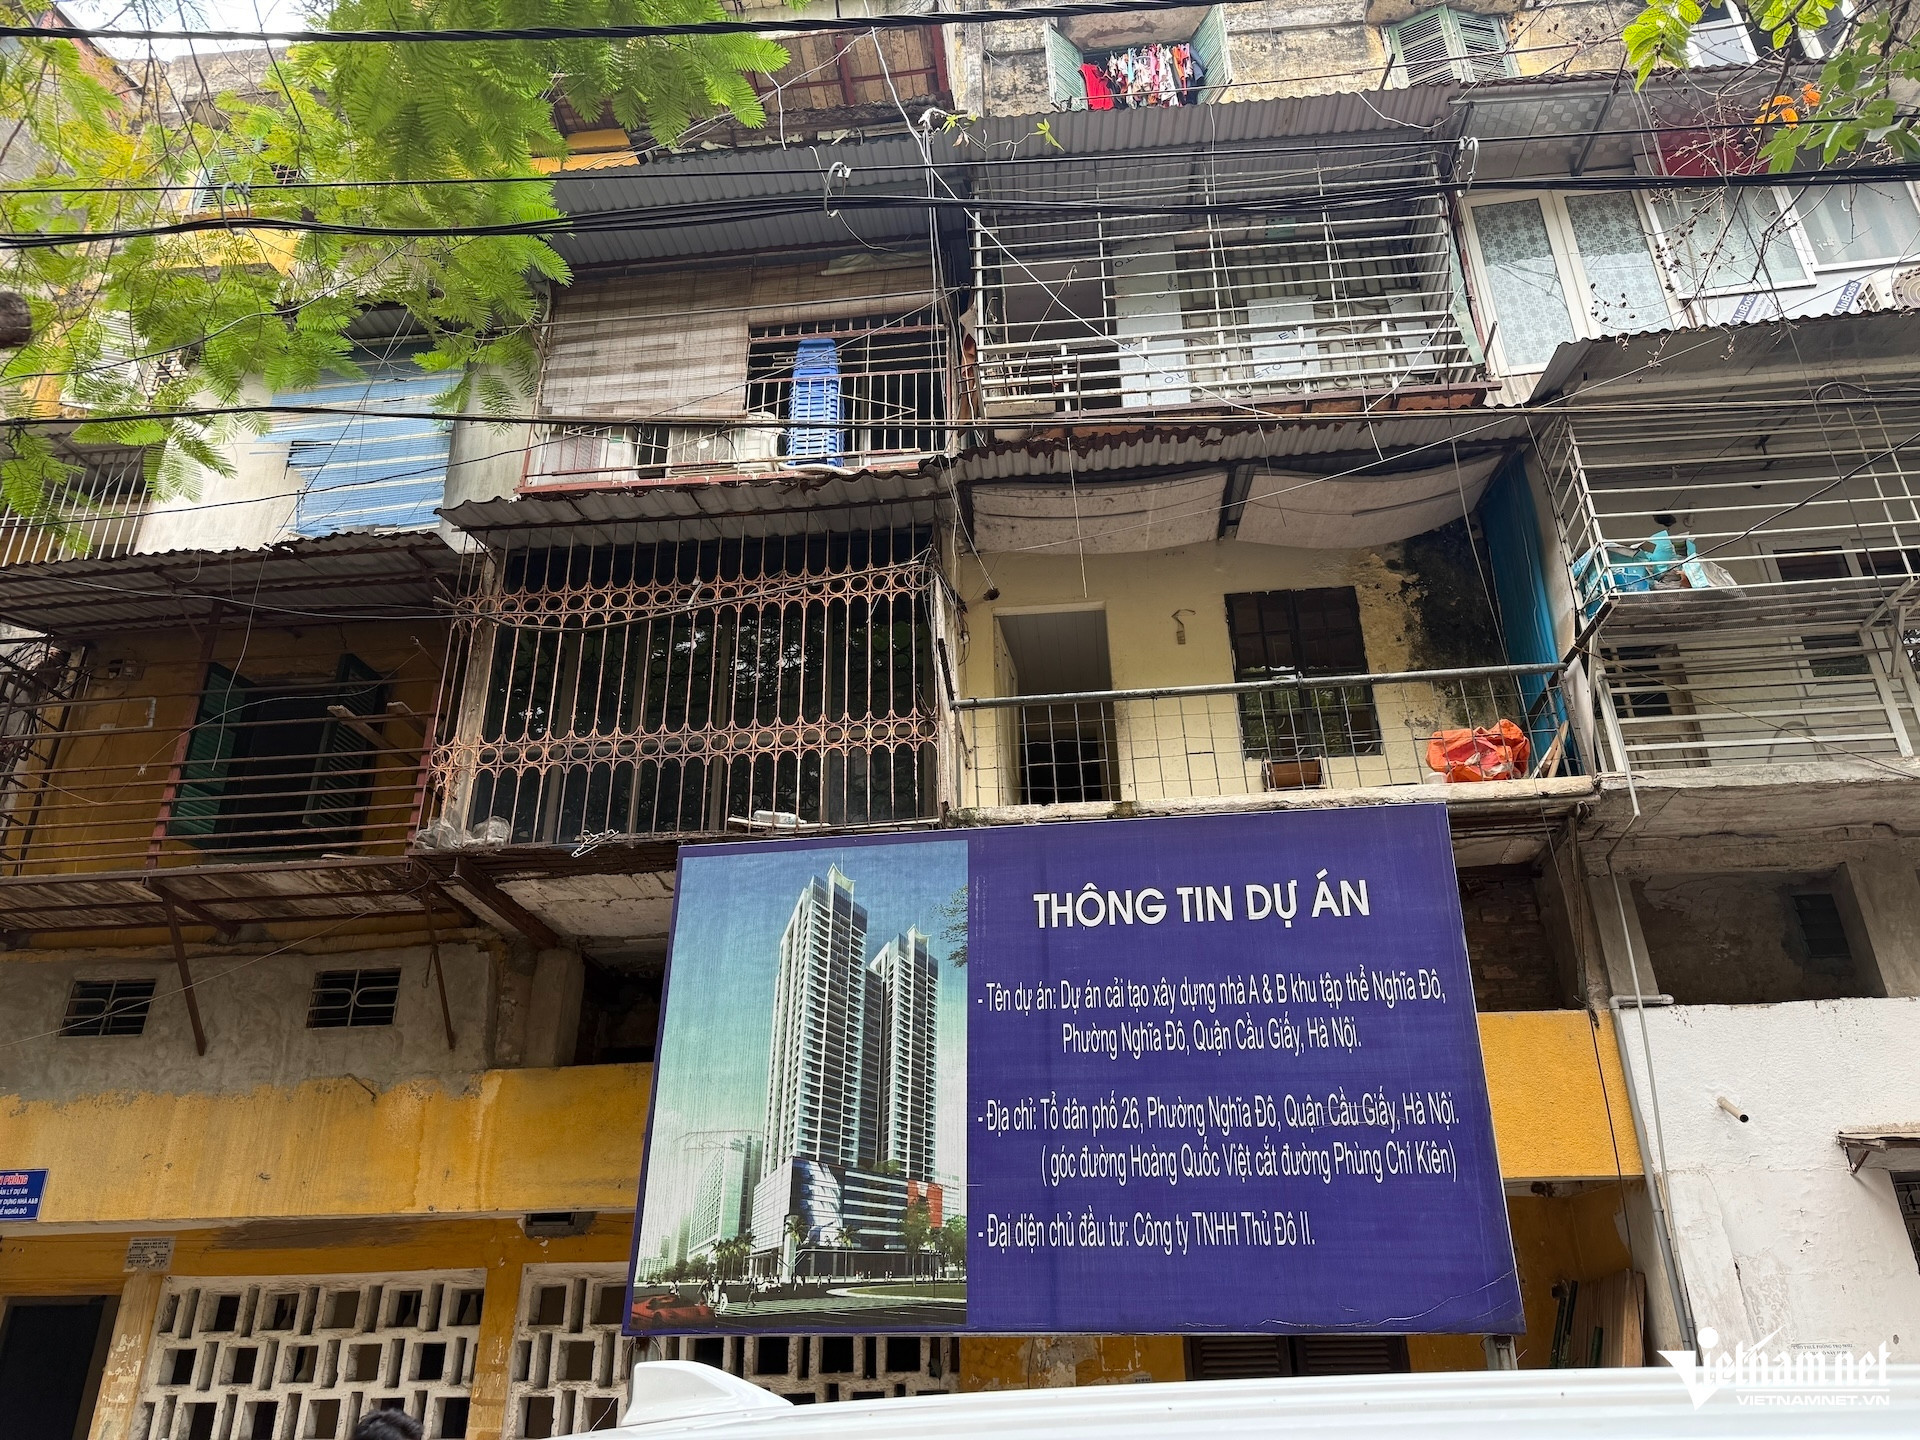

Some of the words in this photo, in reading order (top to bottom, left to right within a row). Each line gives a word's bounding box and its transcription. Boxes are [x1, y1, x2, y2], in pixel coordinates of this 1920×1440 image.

[1034, 882, 1166, 928] THÔNG
[1176, 886, 1234, 922] TIN
[1246, 880, 1298, 928] DỰ
[1312, 868, 1370, 918] ÁN
[986, 982, 1010, 1012] Tên
[1014, 982, 1032, 1016] dự
[1036, 980, 1056, 1010] án:
[1060, 980, 1082, 1014] Dự
[1084, 978, 1102, 1008] án
[1104, 976, 1124, 1008] cải
[1128, 980, 1148, 1014] tạo
[1152, 976, 1176, 1014] xây
[1180, 976, 1216, 1014] dựng
[1220, 974, 1246, 1004] nhà
[1248, 974, 1260, 1004] A
[1262, 974, 1274, 1004] &
[1276, 974, 1288, 1004] B
[1290, 972, 1318, 1002] khu
[1320, 972, 1342, 1010] tập
[1346, 964, 1370, 1002] thể
[1372, 970, 1418, 1008] Nghĩa
[1418, 968, 1446, 1004] Đô,
[1062, 1022, 1118, 1060] Phường
[1120, 1022, 1162, 1060] Nghĩa
[1164, 1020, 1190, 1056] Đô,
[1194, 1020, 1232, 1056] Quận
[1234, 1012, 1264, 1050] Cầu
[1268, 1010, 1304, 1056] Giấy,
[1306, 1016, 1330, 1048] Hà
[1332, 1016, 1362, 1054] Nội.
[986, 1100, 1010, 1138] Địa
[1014, 1098, 1036, 1130] chỉ:
[1040, 1090, 1058, 1130] Tổ
[1062, 1098, 1088, 1130] dân
[1092, 1090, 1118, 1138] phố
[1122, 1096, 1144, 1134] 26,
[1146, 1096, 1206, 1136] Phường
[1208, 1096, 1252, 1136] Nghĩa
[1254, 1094, 1282, 1132] Đô,
[1284, 1094, 1324, 1134] Quận
[1328, 1086, 1360, 1128] Cầu
[1360, 1086, 1400, 1134] Giấy,
[1402, 1092, 1426, 1124] Hà
[1428, 1092, 1460, 1130] Nội.
[1080, 1144, 1126, 1186] đường
[1130, 1144, 1178, 1186] Hoàng
[1180, 1136, 1220, 1178] Quốc
[1222, 1142, 1252, 1184] Việt
[1256, 1136, 1278, 1176] cắt
[1280, 1142, 1332, 1184] đường
[1332, 1142, 1384, 1184] Phùng
[1386, 1140, 1412, 1174] Chí
[1414, 1140, 1456, 1182] Kiên)
[986, 1214, 1010, 1254] Đại
[1014, 1212, 1044, 1254] diện
[1048, 1210, 1074, 1246] chủ
[1078, 1204, 1106, 1246] đầu
[1108, 1214, 1130, 1246] tư:
[1134, 1212, 1172, 1256] Công
[1176, 1214, 1188, 1256] ty
[1192, 1212, 1238, 1246] TNHH
[1240, 1210, 1272, 1246] Thủ
[1274, 1210, 1296, 1246] Đô
[1300, 1210, 1316, 1244] II.
